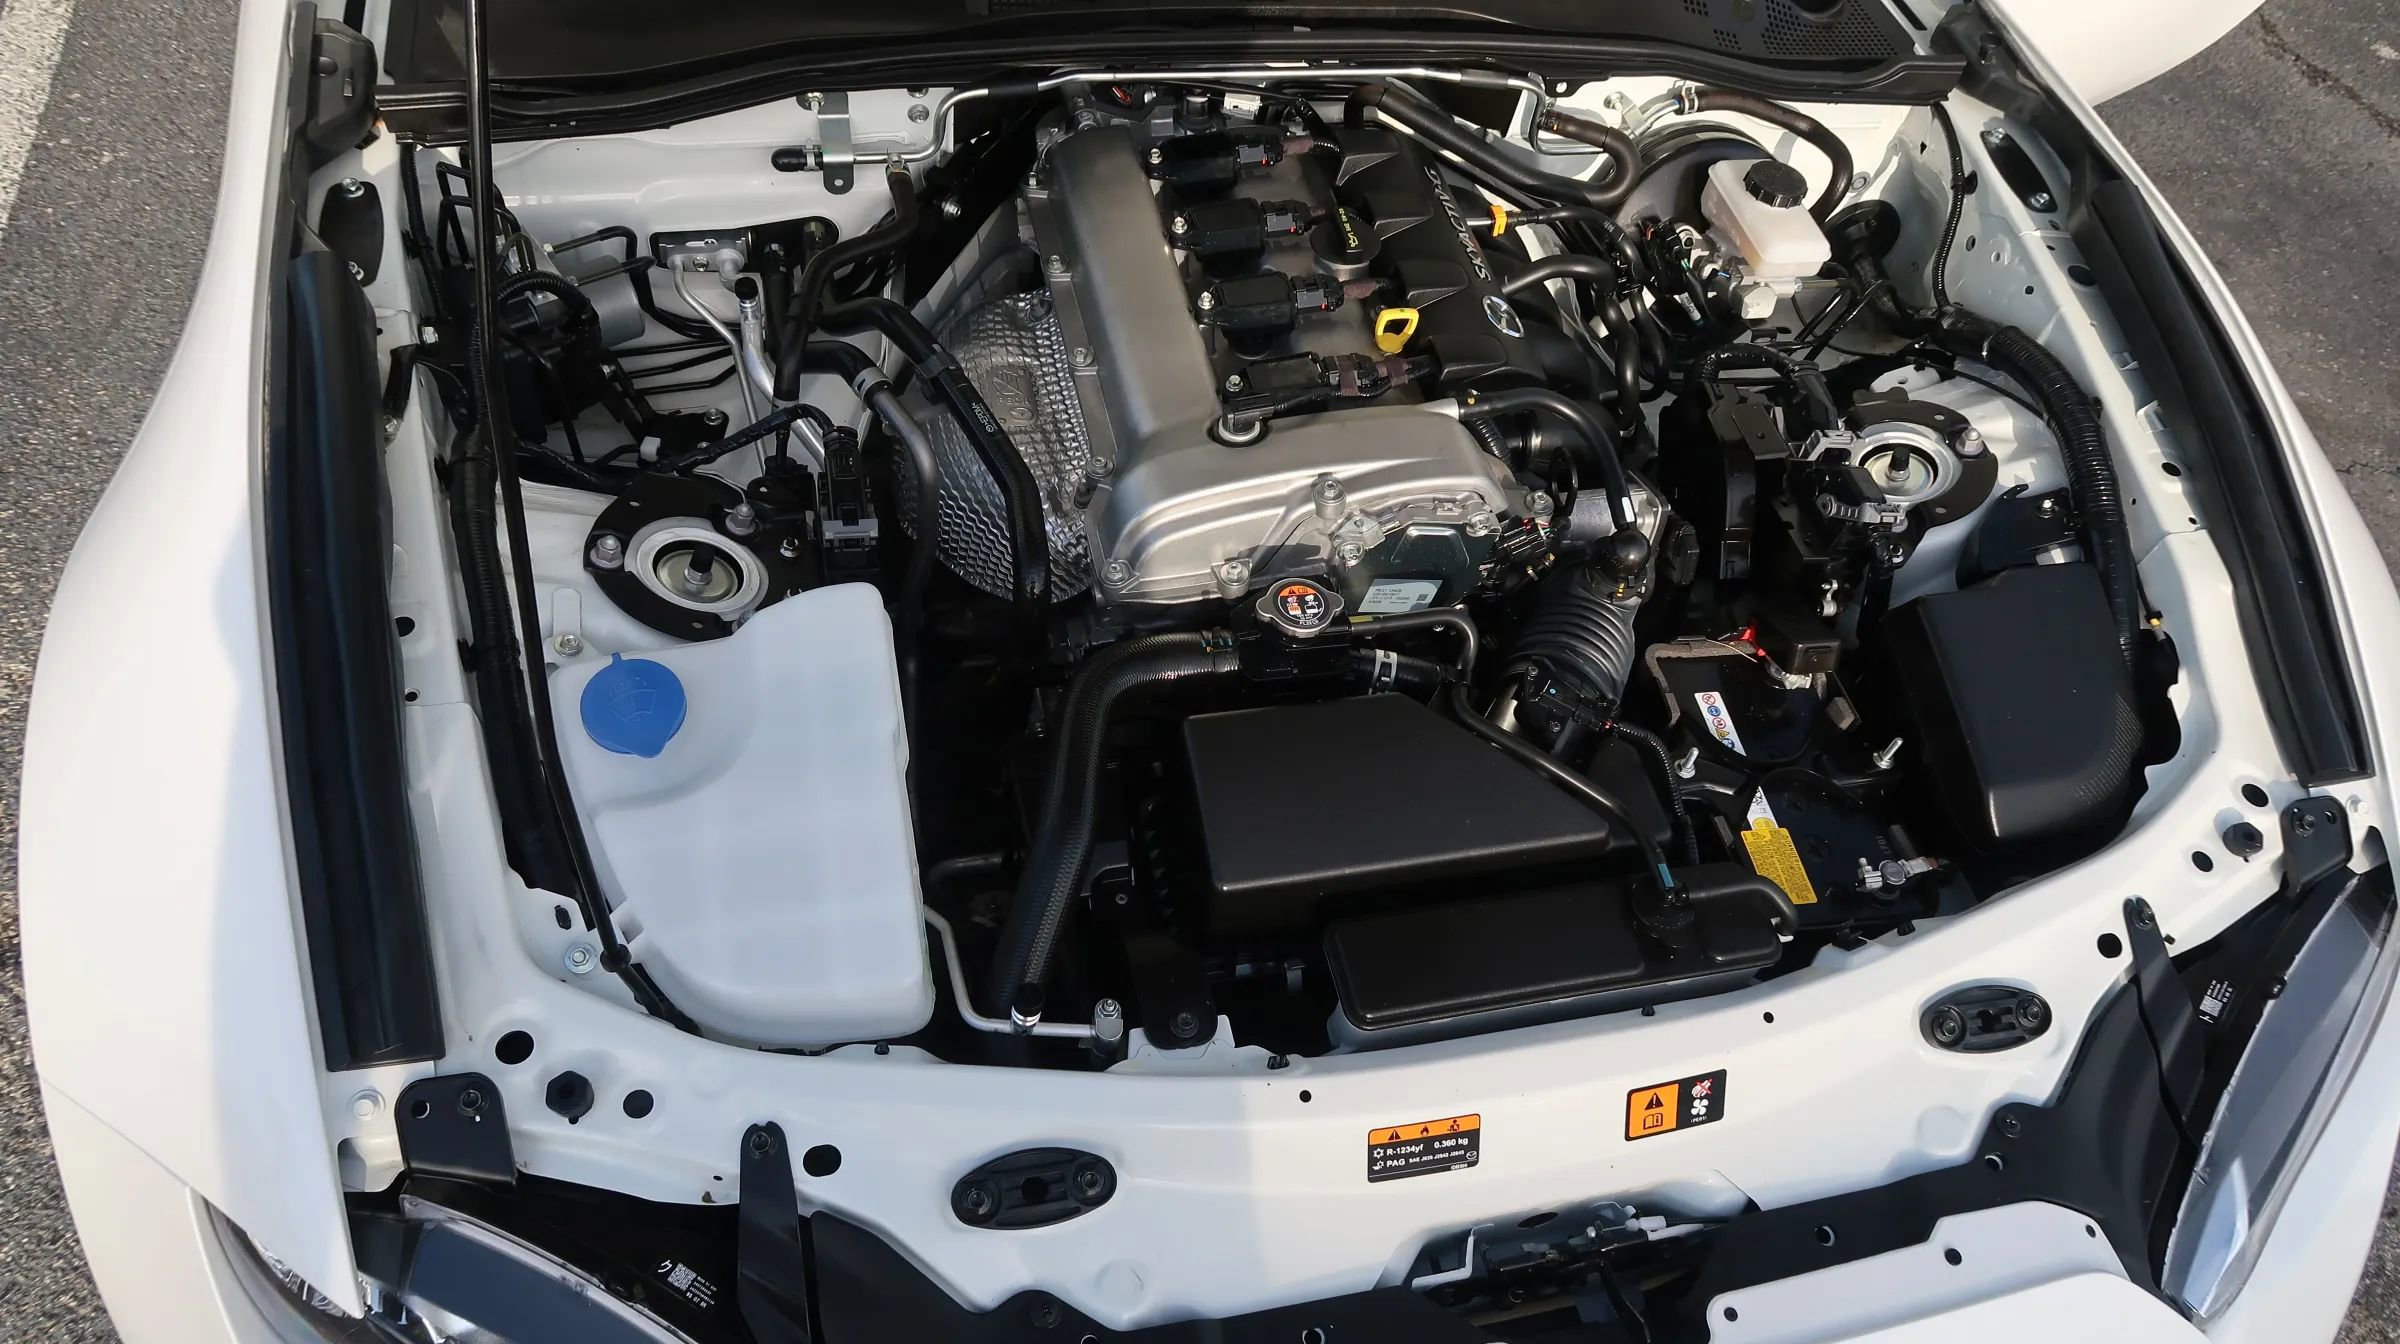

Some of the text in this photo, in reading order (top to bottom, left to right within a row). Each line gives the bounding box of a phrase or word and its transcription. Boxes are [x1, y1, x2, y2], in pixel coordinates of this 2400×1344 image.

[1424, 165, 1491, 282] SKYACTIV-G
[1386, 1137, 1469, 1157] R-1234yf 0.360 kg
[1386, 1158, 1406, 1168] PAG
